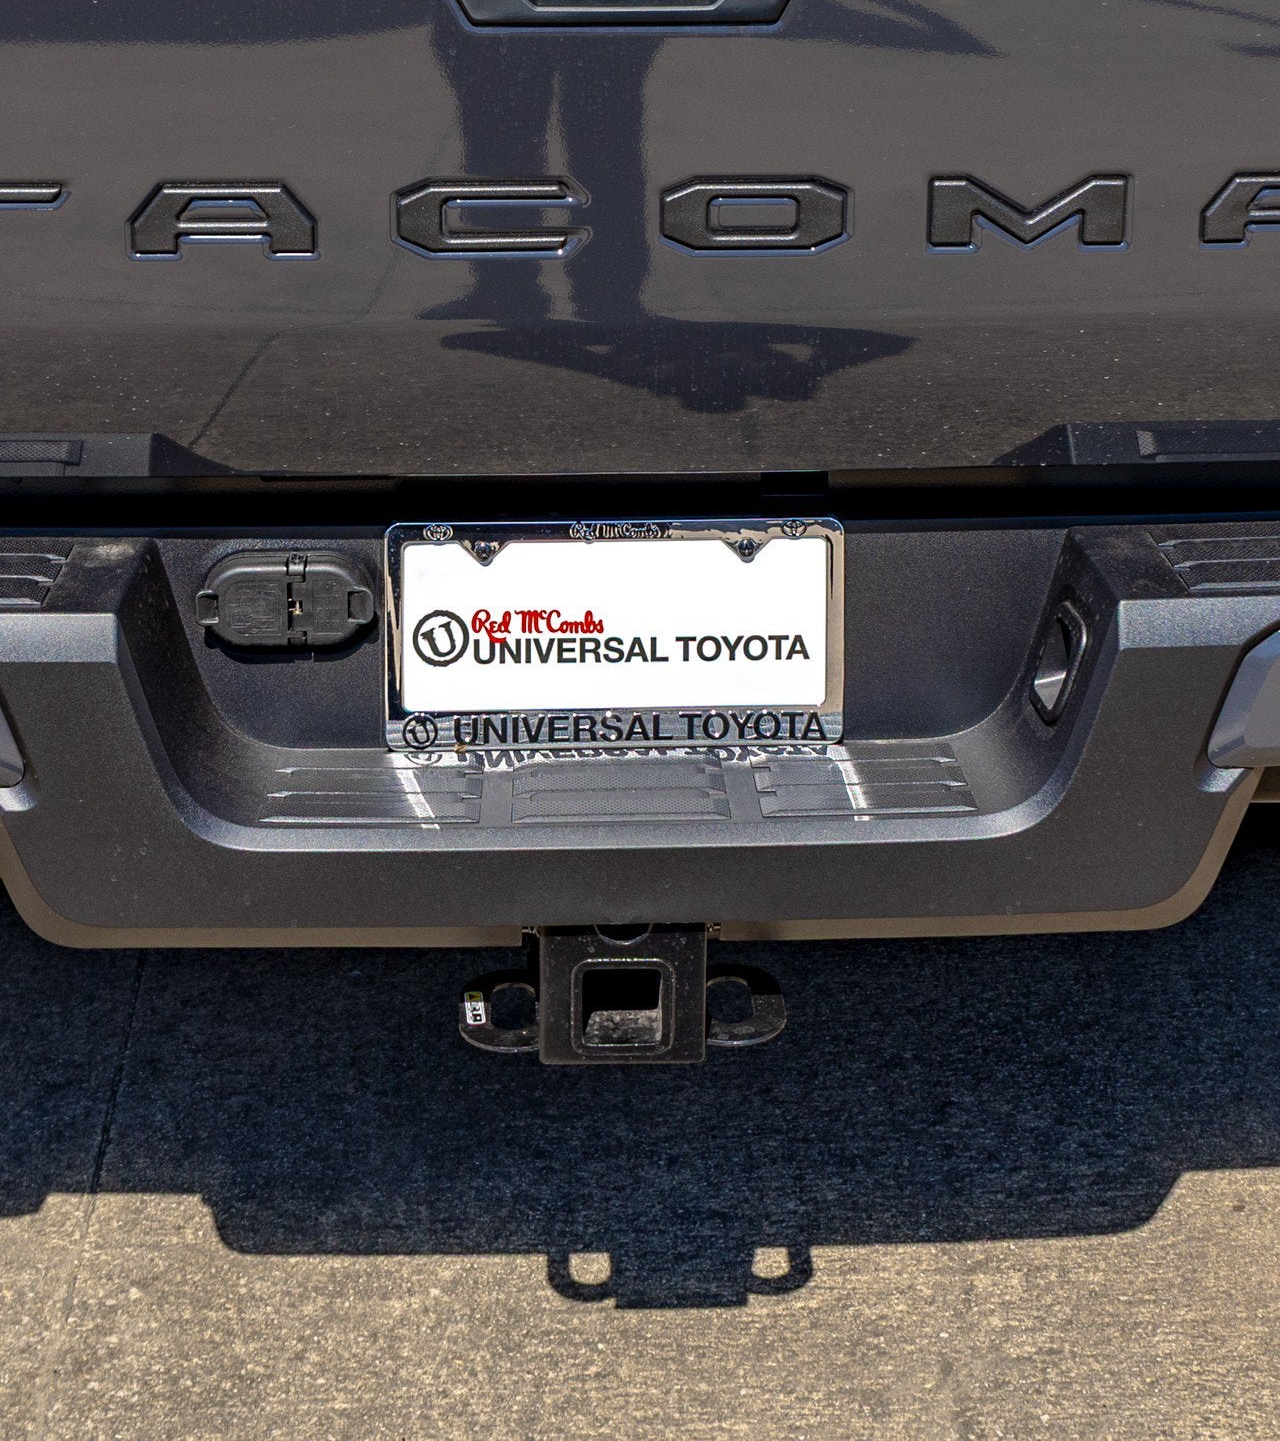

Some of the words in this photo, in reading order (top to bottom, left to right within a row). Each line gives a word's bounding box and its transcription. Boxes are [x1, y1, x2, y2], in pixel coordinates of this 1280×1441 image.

[472, 609, 511, 643] Red
[515, 609, 604, 634] McCombs
[473, 636, 669, 665] UNIVERSAL
[675, 634, 810, 662] TOYOTA
[453, 712, 672, 744] UNIVERSAL
[679, 710, 829, 742] TOYOTA
